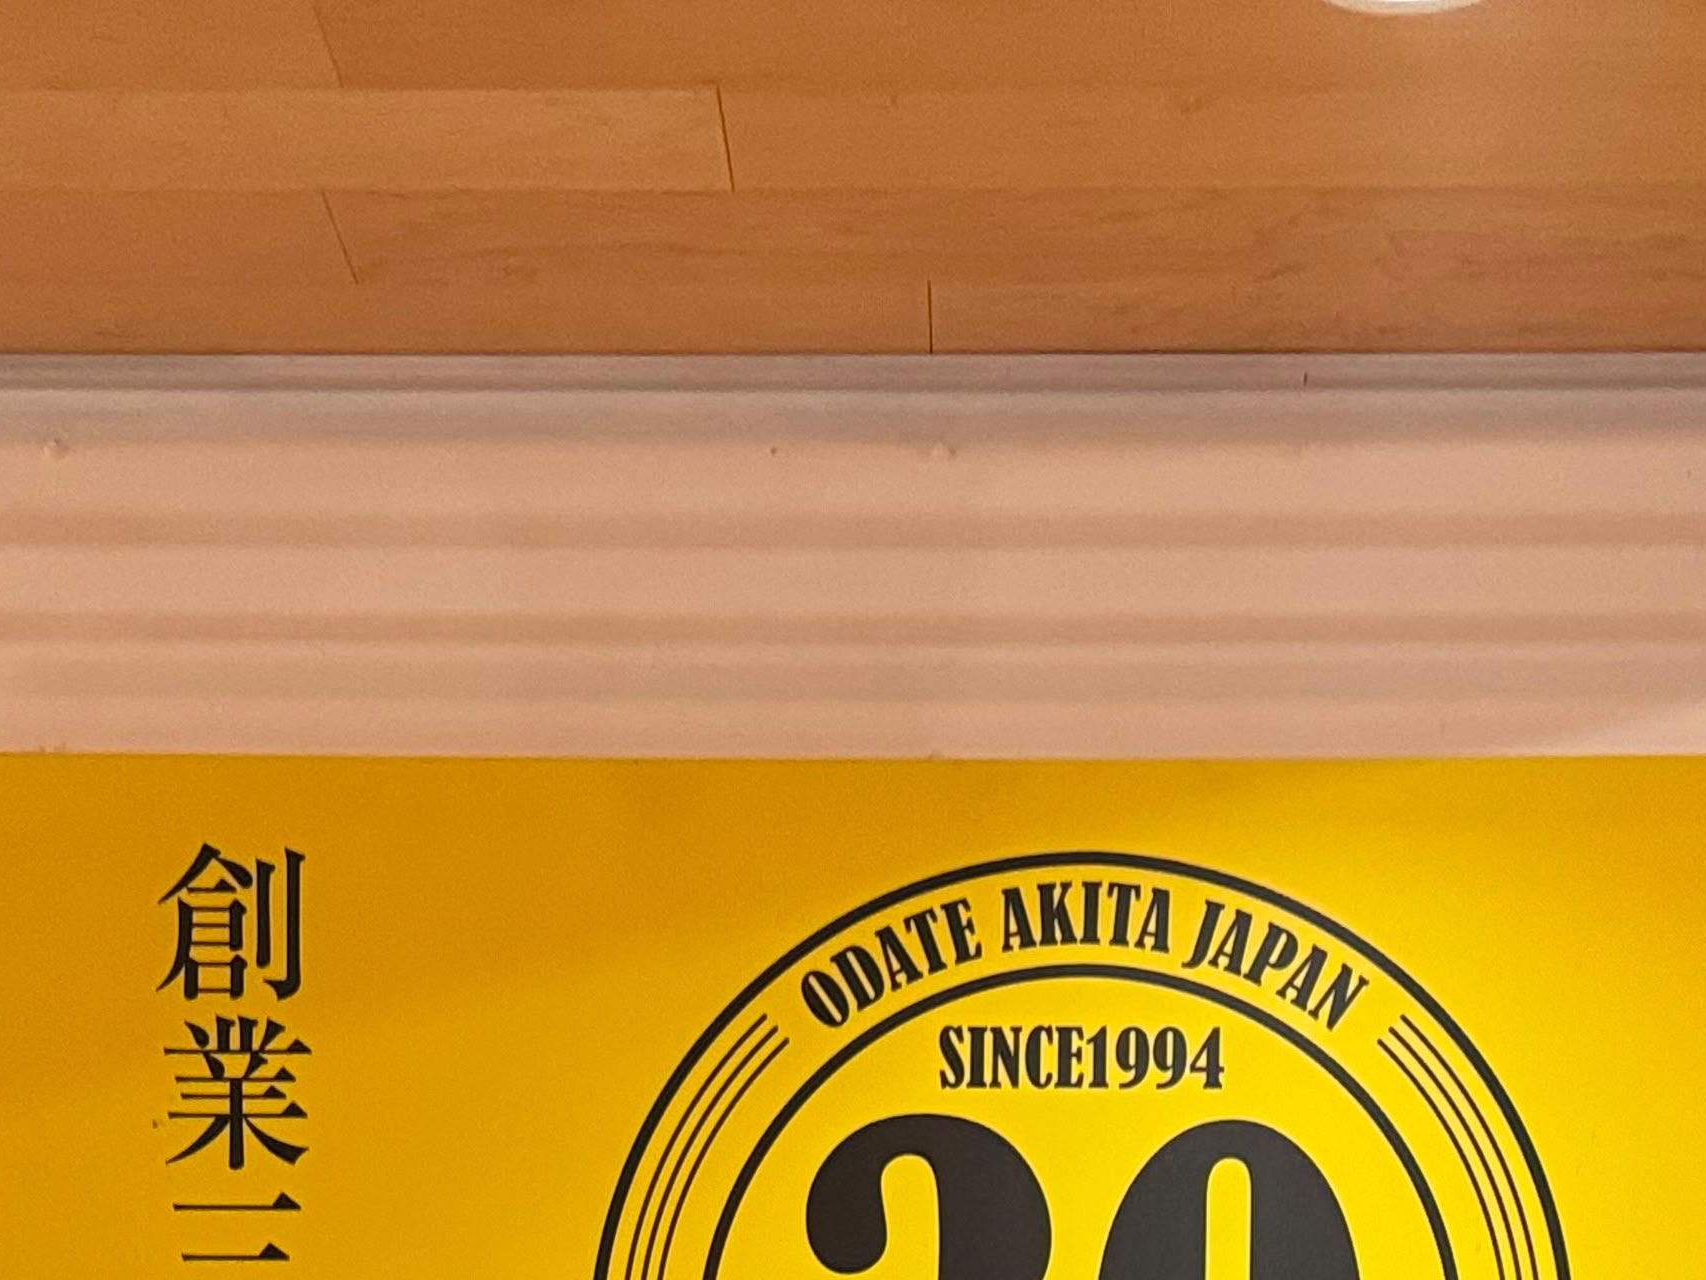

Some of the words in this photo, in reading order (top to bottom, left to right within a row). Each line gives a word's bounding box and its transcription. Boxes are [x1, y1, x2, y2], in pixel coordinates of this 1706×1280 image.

[800, 897, 983, 1029] ODATE
[1000, 881, 1171, 954] AKITA
[1181, 899, 1369, 1031] JAPAN
